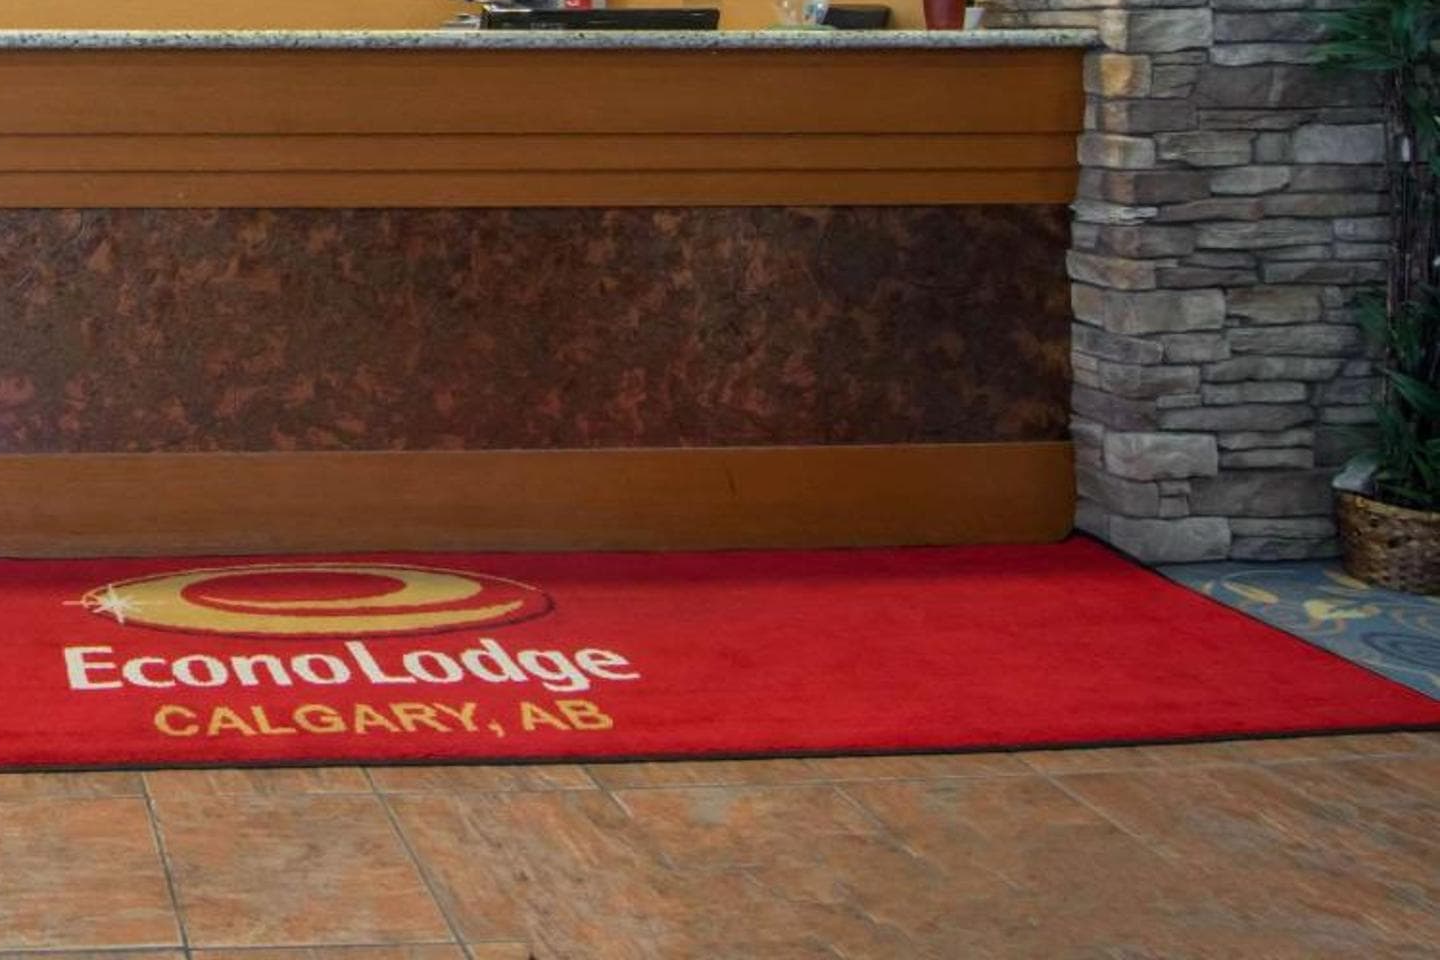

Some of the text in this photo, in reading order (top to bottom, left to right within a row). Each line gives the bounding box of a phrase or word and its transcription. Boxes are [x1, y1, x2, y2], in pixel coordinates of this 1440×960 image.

[64, 638, 640, 693] EconoLodge
[154, 699, 613, 738] CALGARY, AB
